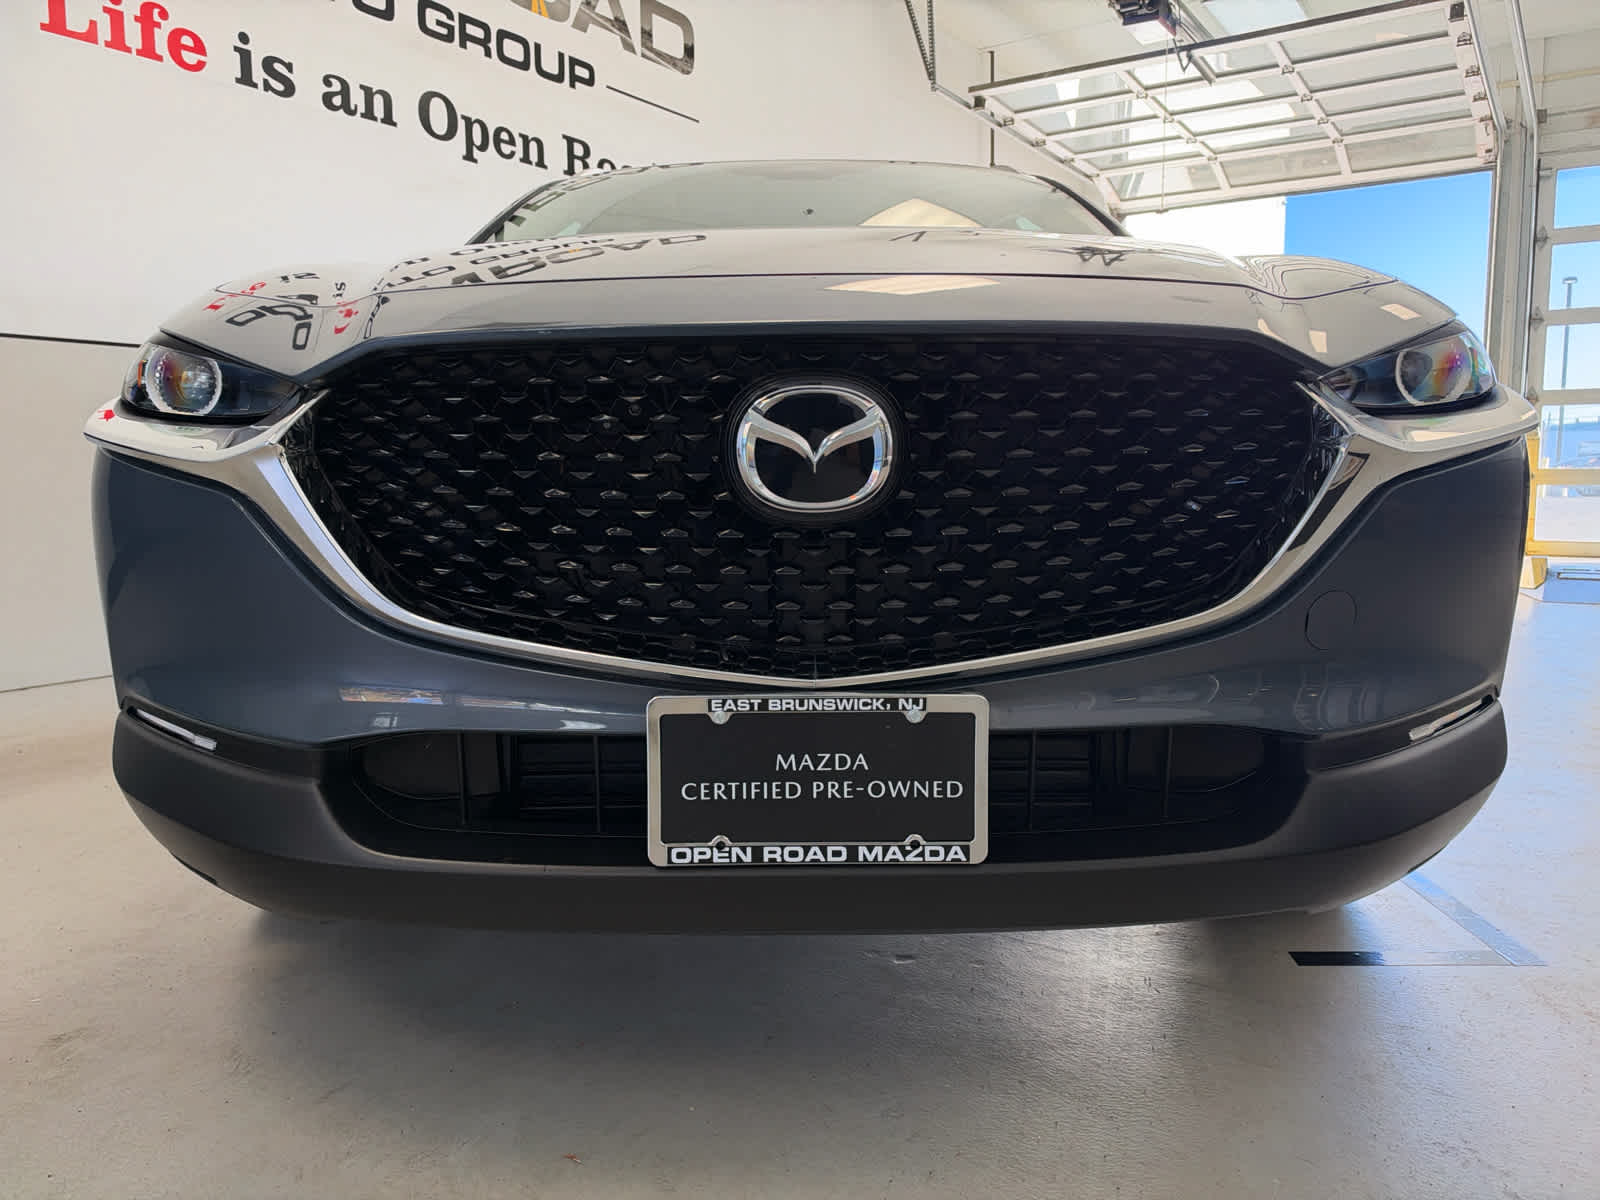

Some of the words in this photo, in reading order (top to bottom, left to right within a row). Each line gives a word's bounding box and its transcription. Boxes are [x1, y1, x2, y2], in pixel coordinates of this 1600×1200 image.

[417, 0, 596, 89] GROUP
[40, 0, 208, 73] Life
[233, 31, 297, 99] is
[321, 73, 398, 128] an
[417, 90, 549, 170] Open
[710, 698, 762, 712] EAST
[767, 698, 892, 712] BRUNSWICK,
[898, 697, 924, 711] NJ
[775, 753, 869, 772] MAZDA
[681, 781, 802, 801] CERTIFIED
[812, 780, 964, 800] PRE-OWNED
[670, 846, 752, 864] OPEN
[762, 845, 848, 863] ROAD
[857, 845, 967, 862] MAZDA
